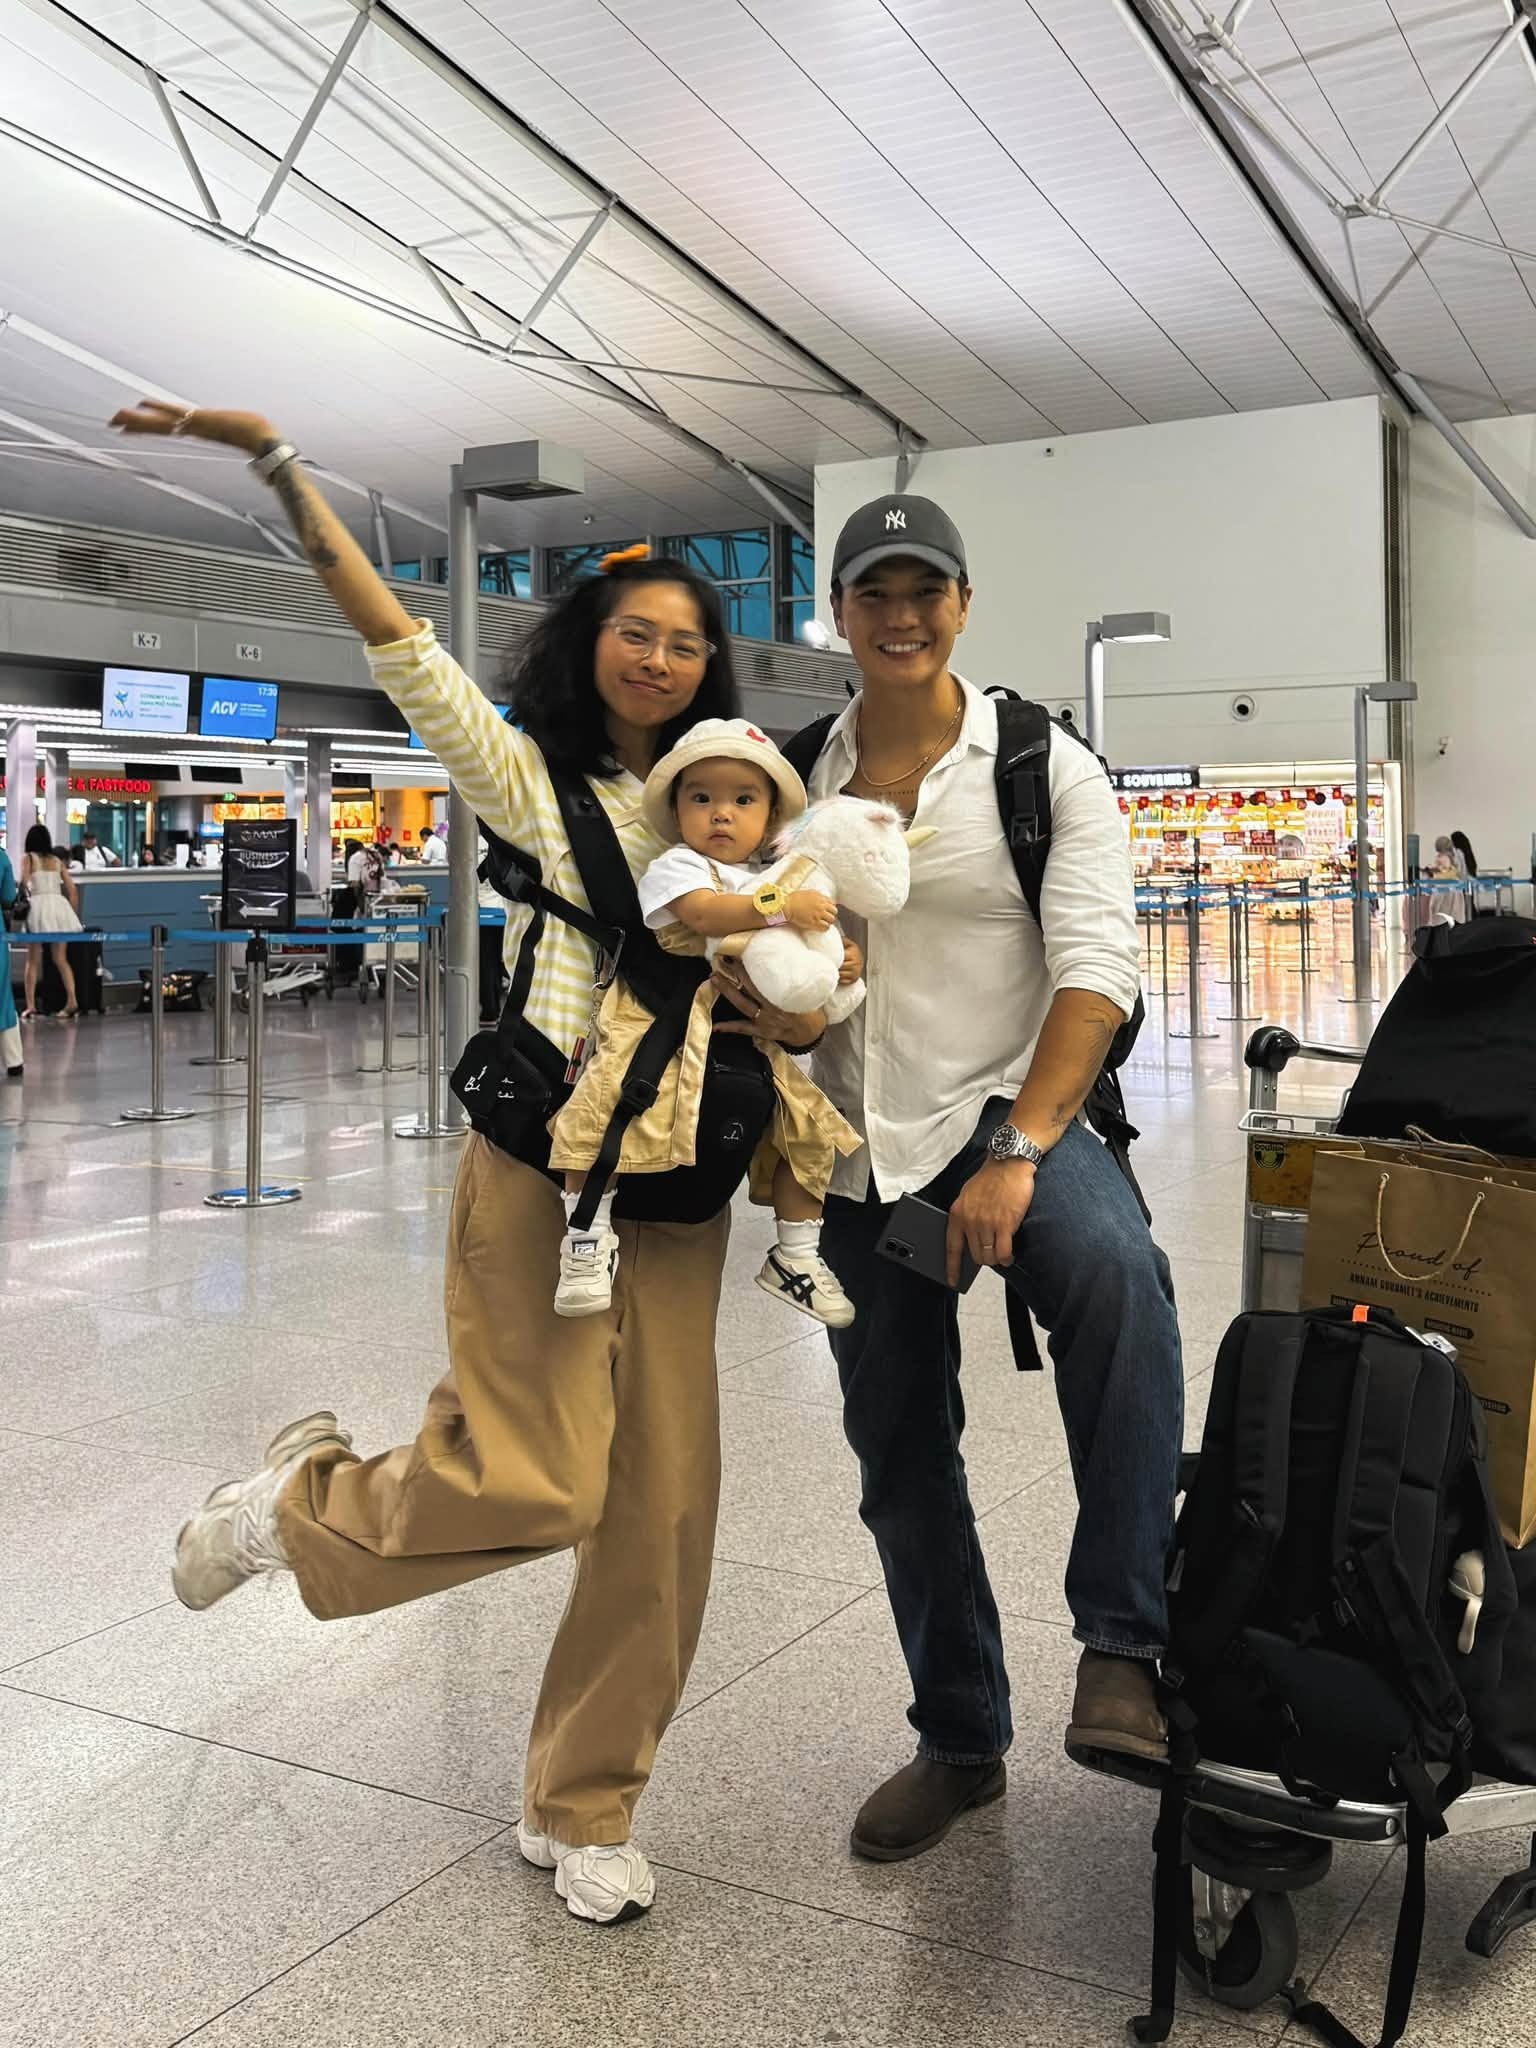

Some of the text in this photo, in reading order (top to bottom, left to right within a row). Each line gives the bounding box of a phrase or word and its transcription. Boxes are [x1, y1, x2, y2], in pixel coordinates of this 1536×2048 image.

[885, 509, 906, 530] NY
[138, 634, 158, 647] K-7
[240, 646, 259, 659] K-6
[76, 777, 86, 791] &
[89, 778, 151, 793] FASTFOOD
[1356, 1231, 1482, 1281] Proud of
[1424, 1291, 1480, 1313] ACHIEVEMENTS
